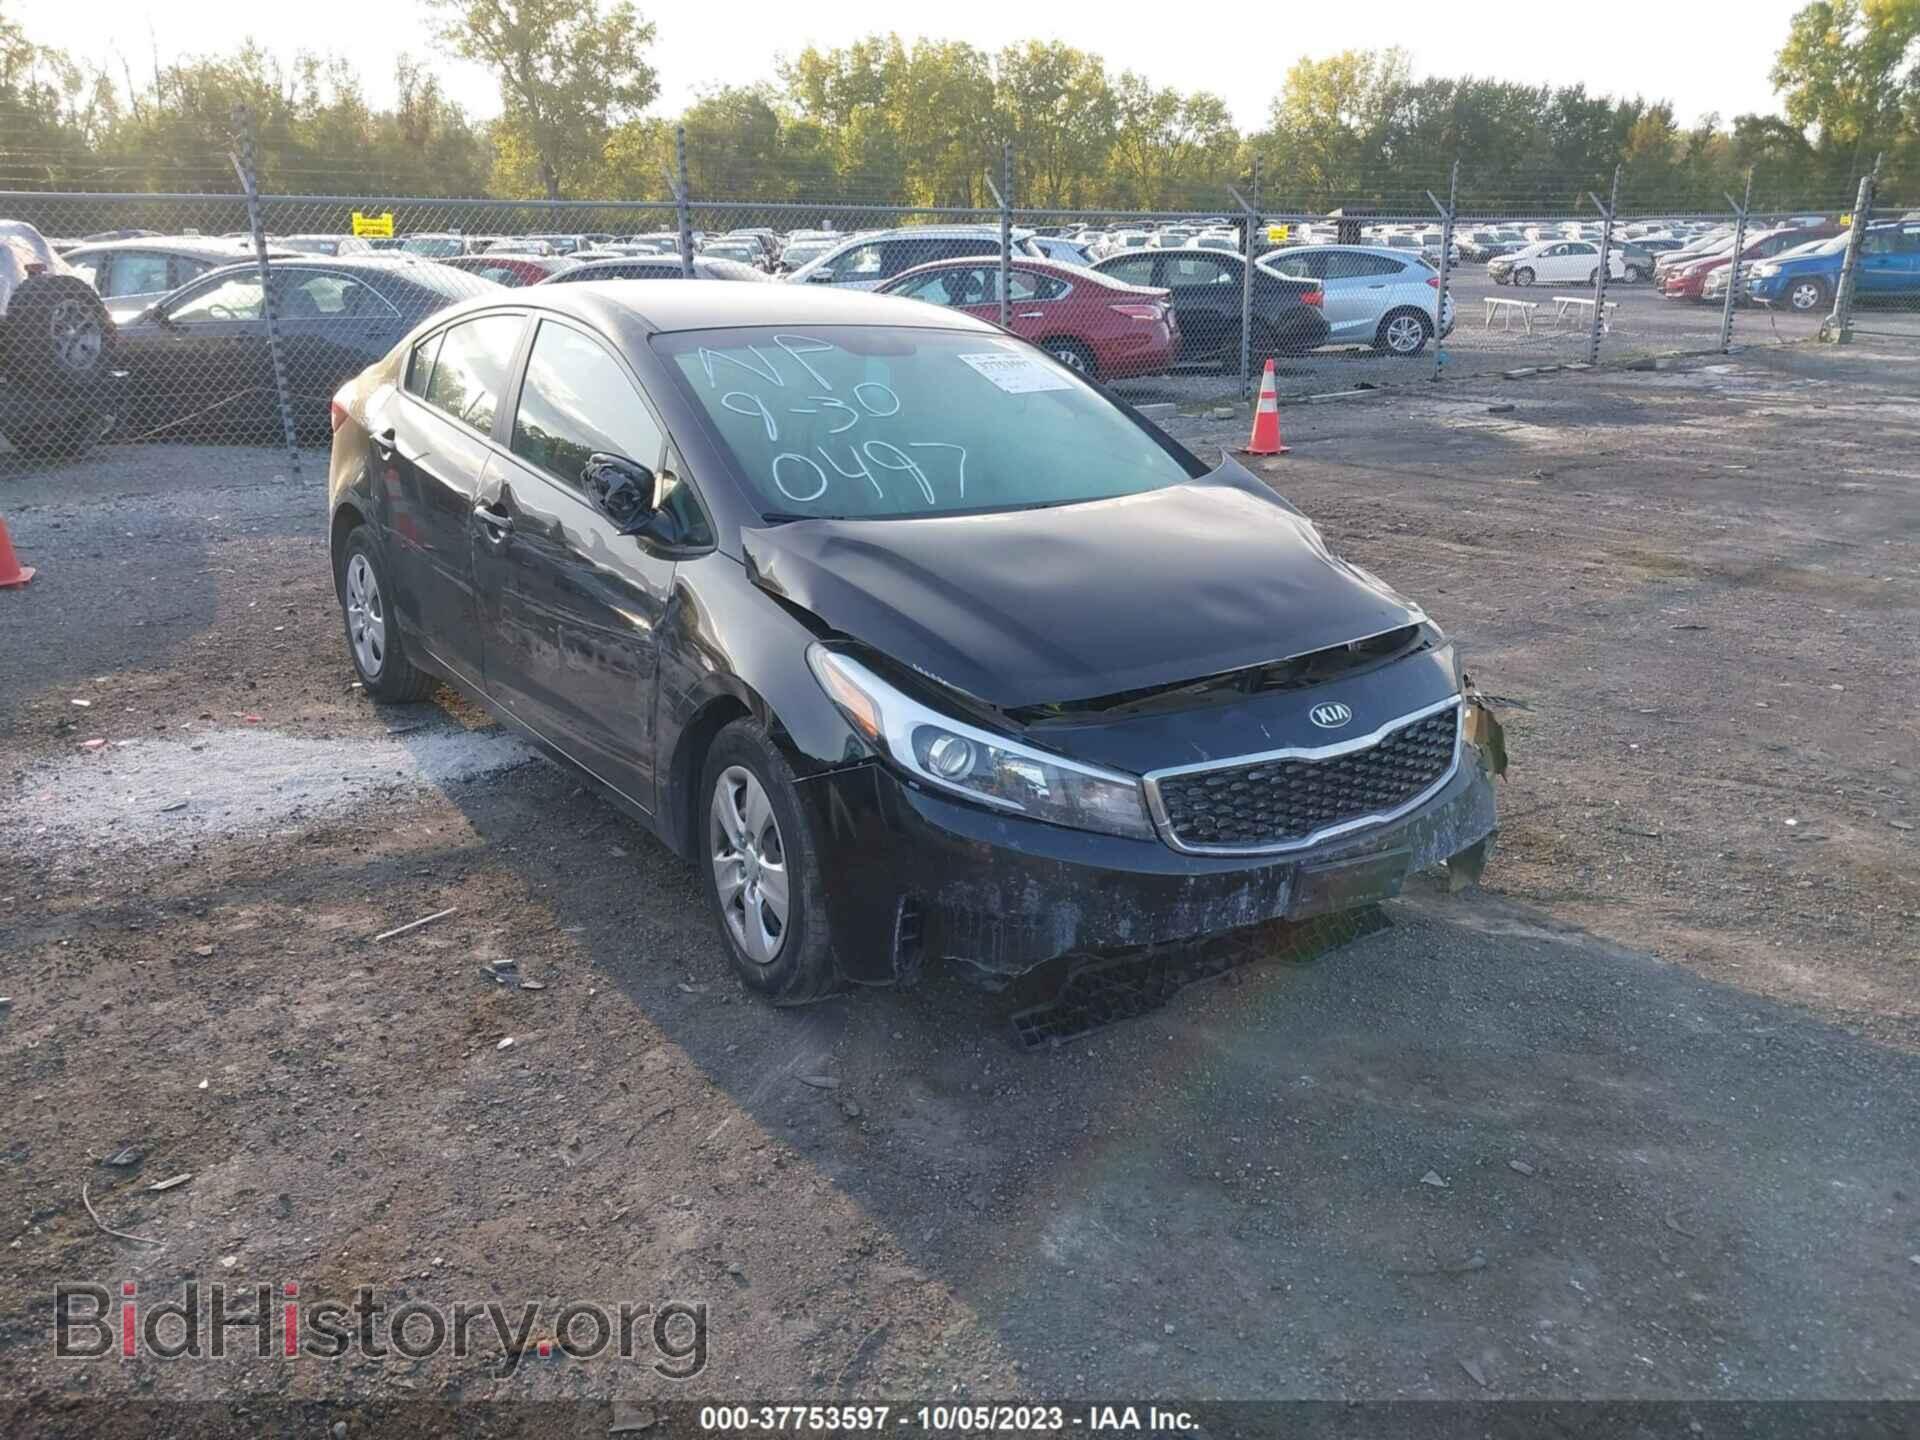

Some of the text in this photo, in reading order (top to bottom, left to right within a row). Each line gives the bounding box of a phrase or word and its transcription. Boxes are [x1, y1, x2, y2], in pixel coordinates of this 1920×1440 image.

[721, 383, 900, 441] 9-30
[773, 440, 966, 504] 0497
[1315, 704, 1349, 724] KIA
